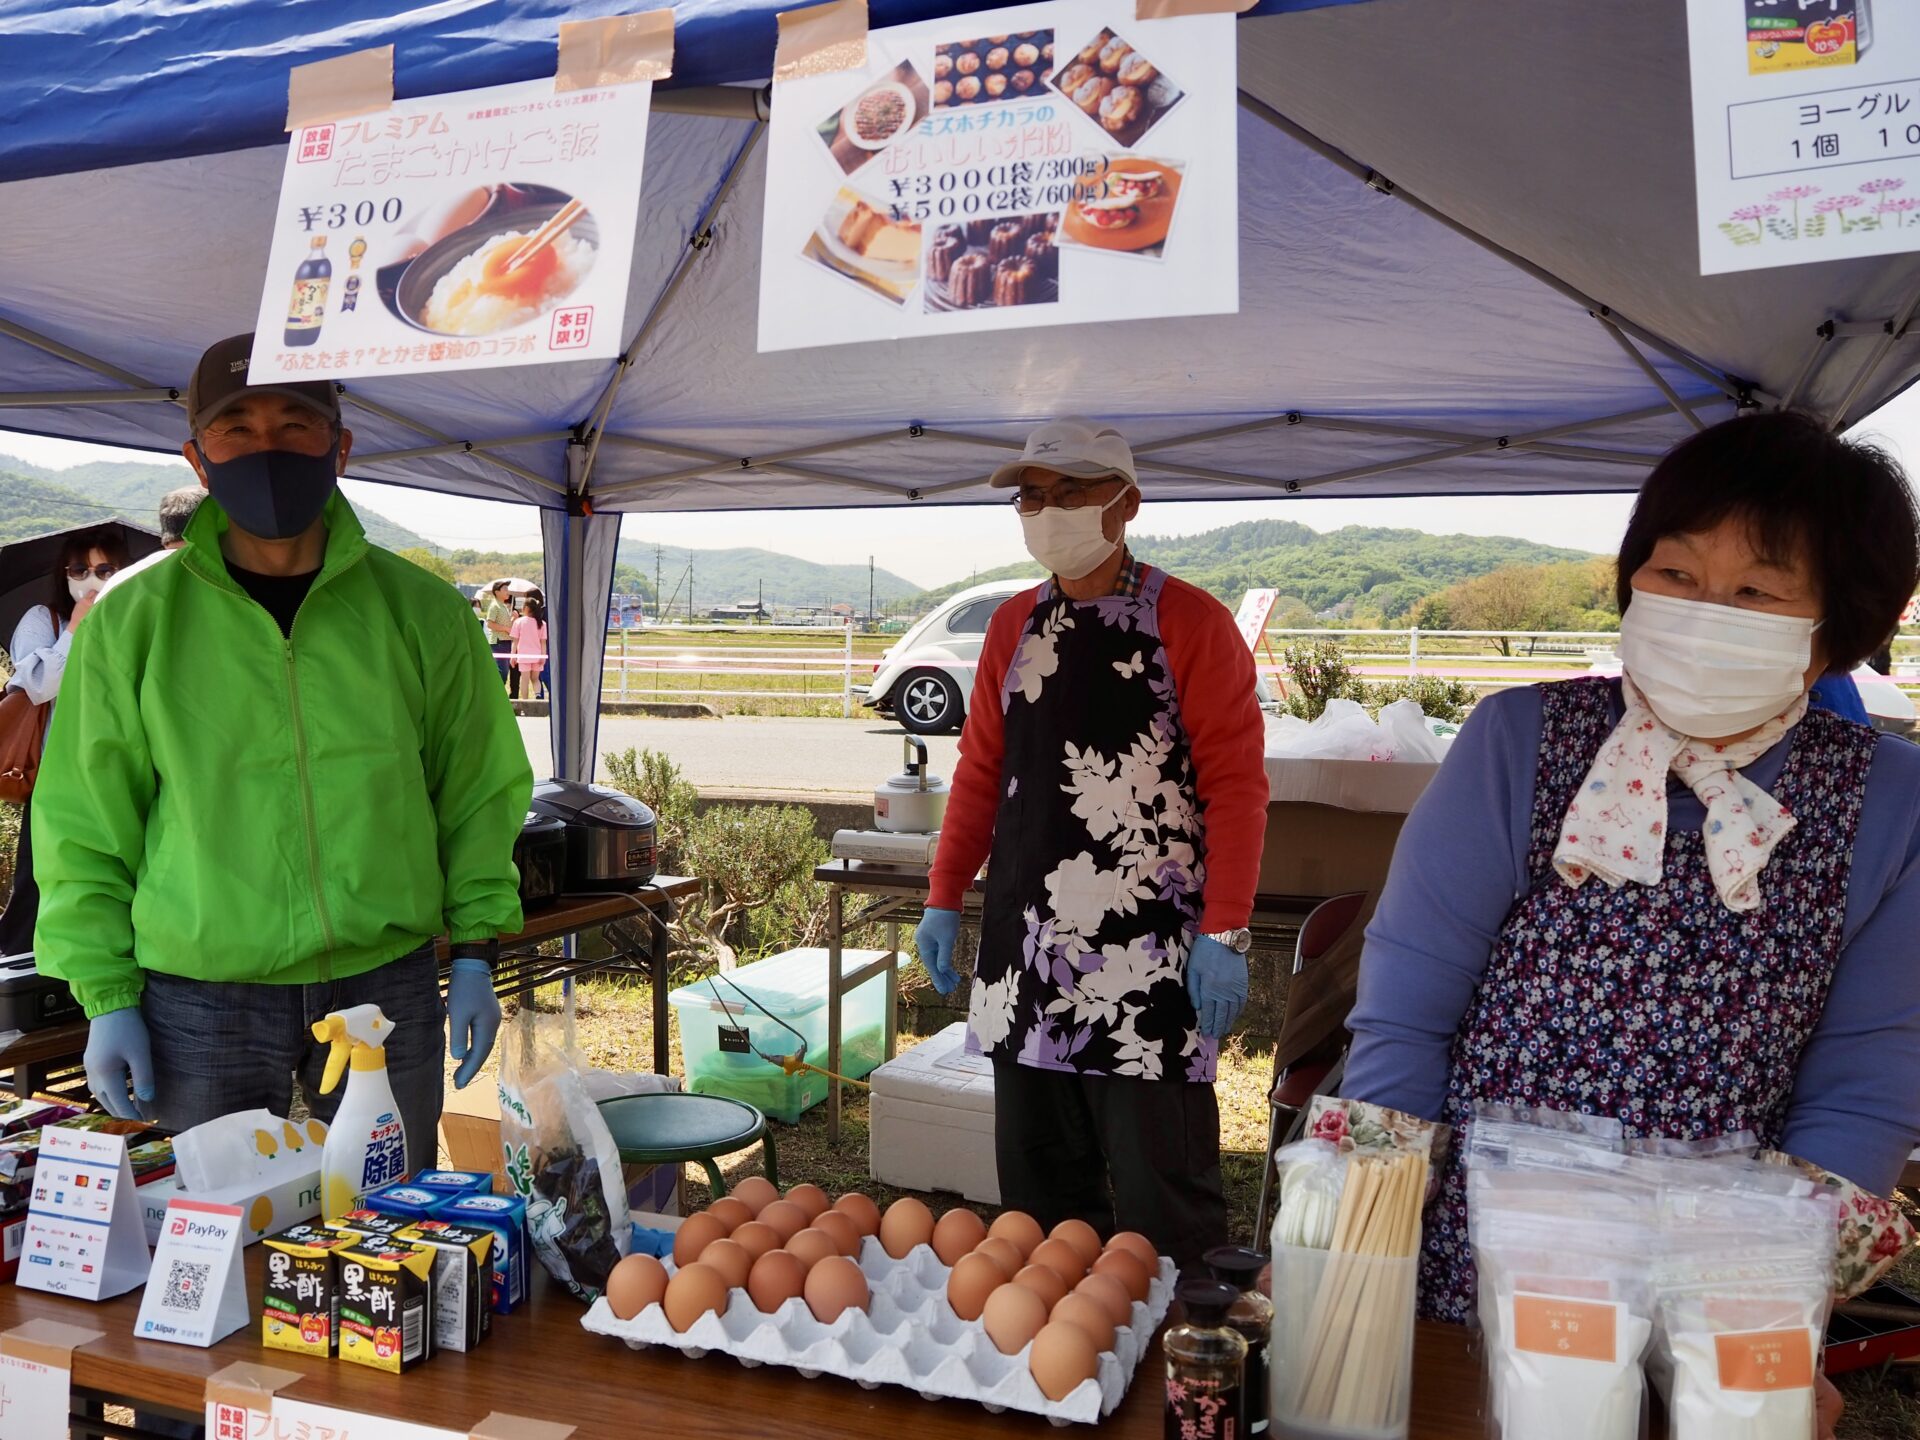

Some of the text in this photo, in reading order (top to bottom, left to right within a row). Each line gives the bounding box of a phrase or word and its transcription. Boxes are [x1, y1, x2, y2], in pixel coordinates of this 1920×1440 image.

[1814, 40, 1839, 52] 10%
[1800, 93, 1920, 126] ヨーグル
[340, 111, 450, 146] プレミアム
[917, 105, 1056, 138] ミズホチカラの
[305, 127, 332, 144] 数量
[303, 142, 328, 158] 限定
[332, 122, 600, 188] たまごかけご飯
[883, 121, 1073, 175] おいしい米粉
[297, 197, 403, 233] ¥300
[558, 311, 588, 329] 本日
[555, 328, 585, 345] 限り
[361, 1143, 405, 1189] 除菌
[187, 1221, 229, 1241] PayPay
[295, 1259, 326, 1272] はちみつ
[268, 1251, 325, 1308] 黒酢
[368, 1271, 397, 1285] はちみつ
[343, 1263, 397, 1322] 黒酢
[154, 1323, 178, 1336] Alipay
[220, 1407, 244, 1425] 数量
[219, 1422, 244, 1440] 限定
[251, 1413, 349, 1440] プレミア
